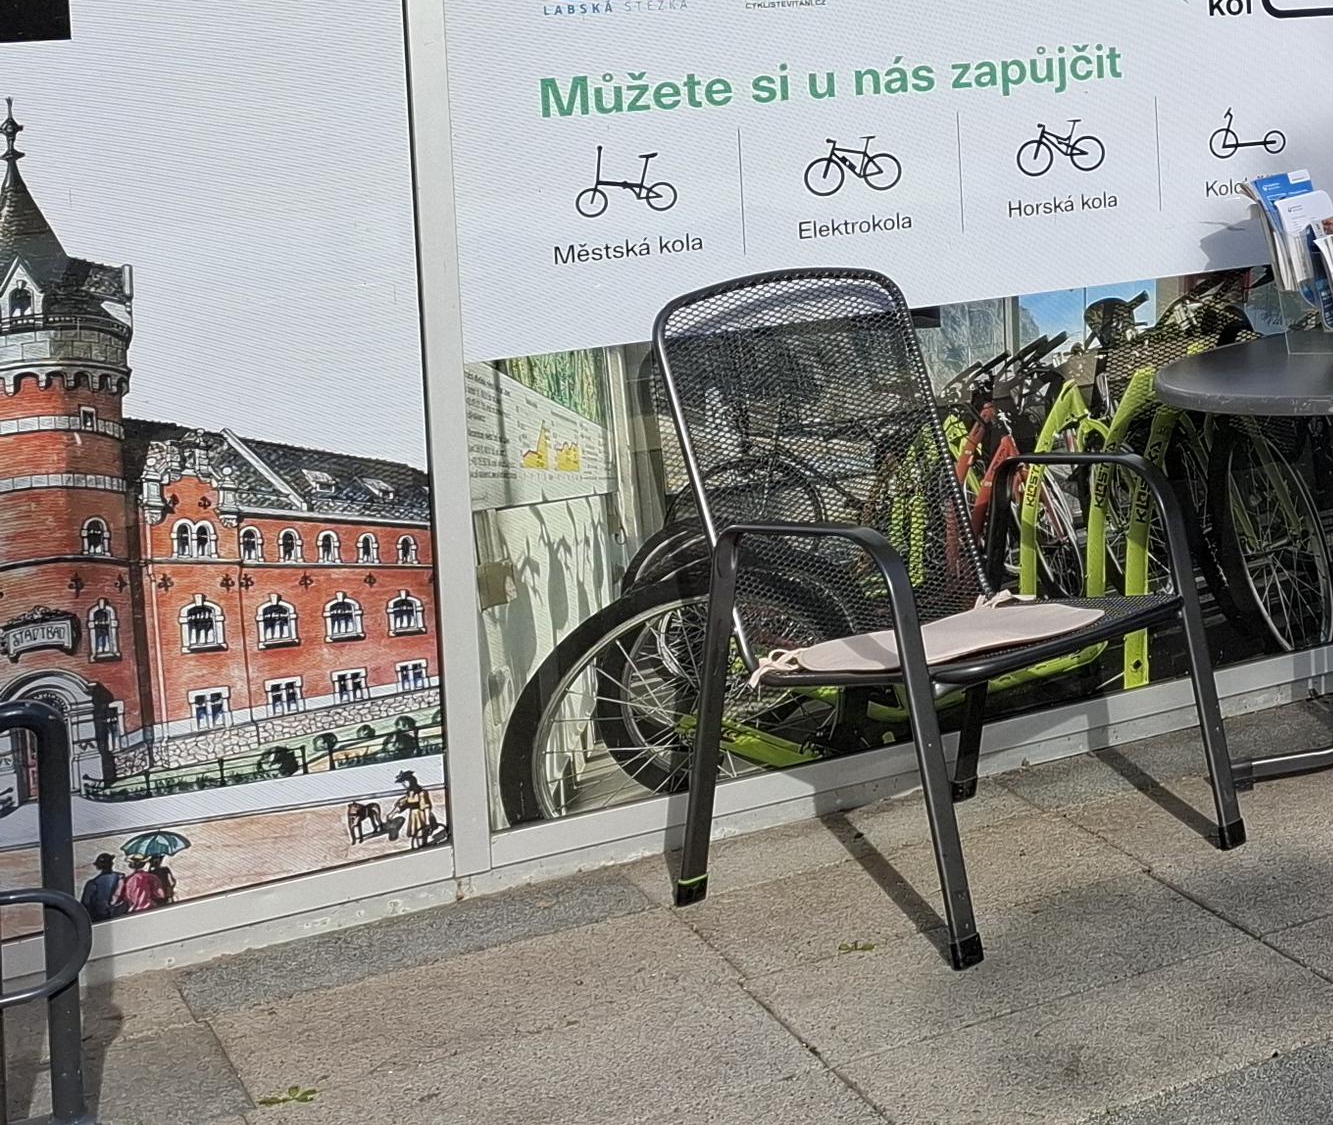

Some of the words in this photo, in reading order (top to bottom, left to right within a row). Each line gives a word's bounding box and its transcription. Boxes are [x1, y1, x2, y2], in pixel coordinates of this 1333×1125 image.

[543, 0, 614, 16] LABSKÁ
[624, 0, 688, 12] STEZKA
[539, 72, 734, 118] Můžete
[752, 63, 790, 103] si
[808, 71, 836, 100] u
[854, 56, 936, 96] nás
[950, 43, 1122, 96] zapůjčit
[1008, 194, 1075, 220] Horská
[1081, 192, 1118, 214] kola
[798, 212, 913, 241] Elektrokola
[553, 237, 652, 266] Městská
[660, 233, 703, 256] kola
